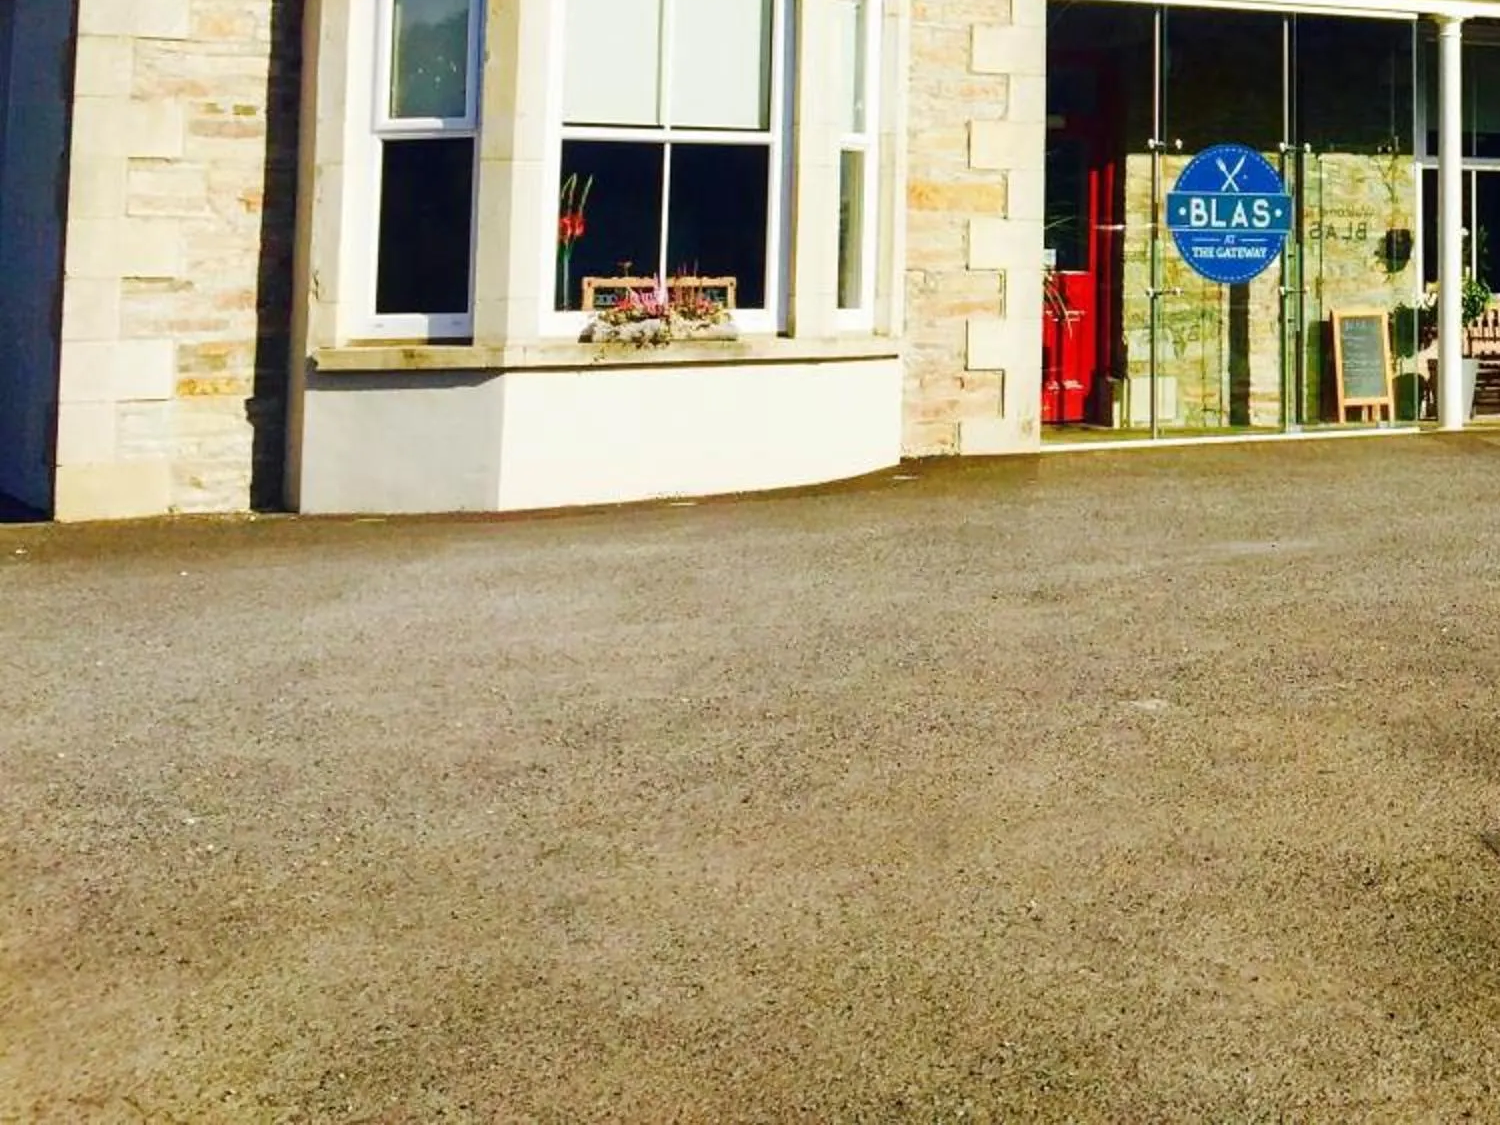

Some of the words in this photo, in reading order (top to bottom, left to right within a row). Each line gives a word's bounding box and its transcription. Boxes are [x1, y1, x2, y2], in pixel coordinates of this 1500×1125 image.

[1190, 197, 1271, 228] BLAS
[1223, 234, 1236, 245] AT
[1192, 246, 1214, 258] THE
[1216, 246, 1268, 259] GATEWAY
